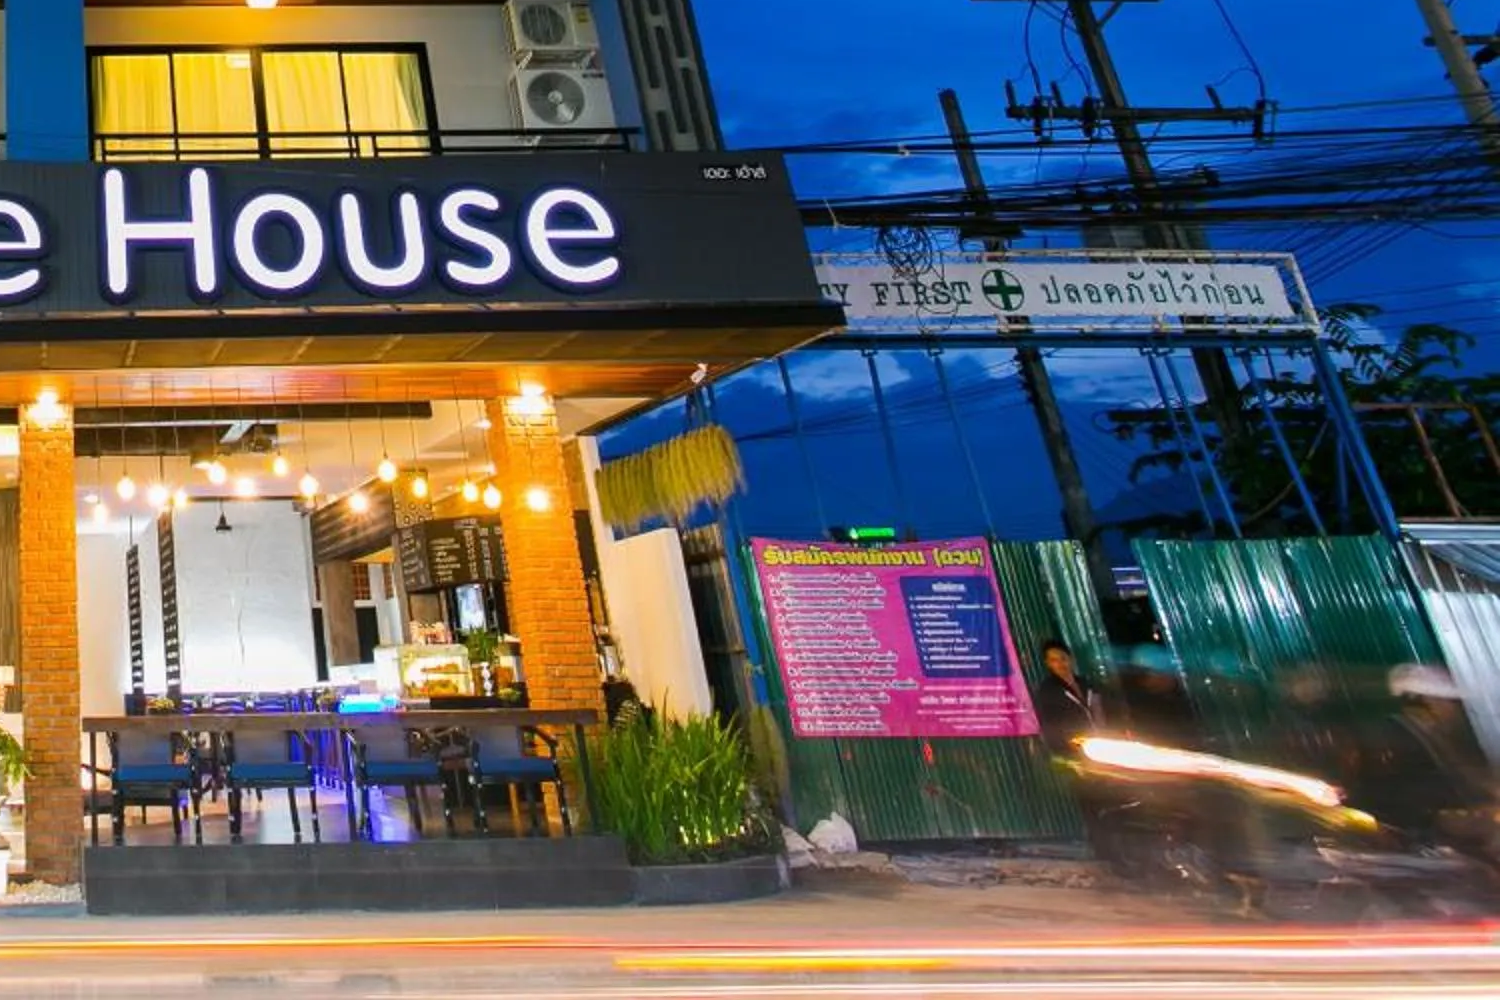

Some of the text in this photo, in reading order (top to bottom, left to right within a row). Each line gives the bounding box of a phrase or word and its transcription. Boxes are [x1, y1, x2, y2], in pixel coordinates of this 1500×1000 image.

[104, 166, 621, 295] House
[870, 281, 973, 307] FIRST
[1040, 268, 1265, 306] ปลอดภัยไว้ก่อน
